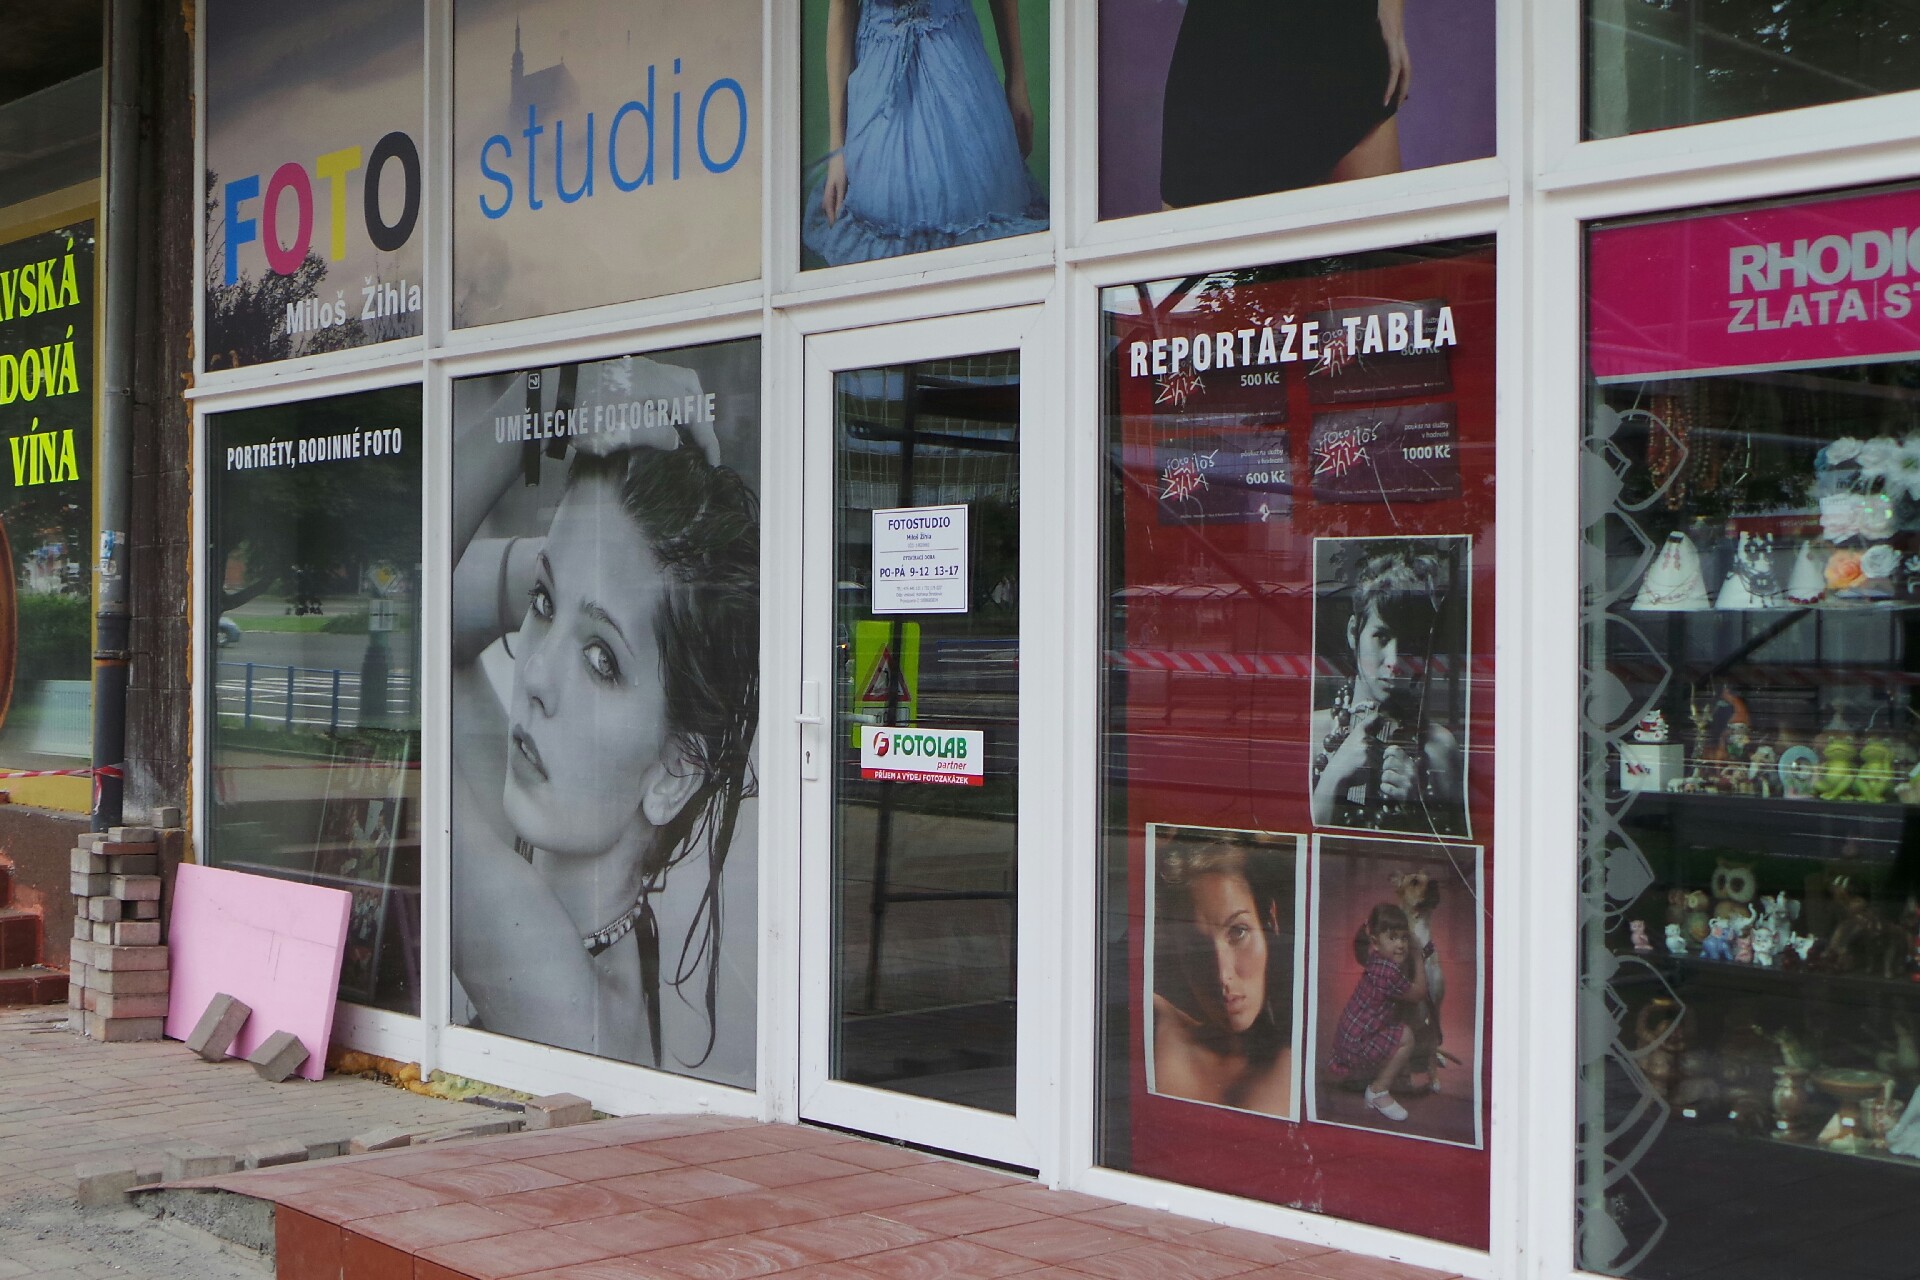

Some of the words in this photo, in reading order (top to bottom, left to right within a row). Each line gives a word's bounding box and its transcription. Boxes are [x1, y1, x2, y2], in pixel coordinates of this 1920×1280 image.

[225, 132, 421, 287] FOTO
[479, 58, 747, 219] studio
[0, 237, 80, 322] VSKÁ
[1729, 227, 1920, 294] RHODI
[286, 290, 346, 335] Miloš
[361, 276, 421, 320] Žihla
[1728, 288, 1868, 334] ZLATA
[1883, 282, 1920, 319] S
[1130, 314, 1331, 377] REPORTÁŽE,
[1342, 306, 1457, 356] TABLA
[1240, 373, 1262, 386] 500
[1265, 371, 1280, 385] Kč
[495, 401, 589, 443] UMĚLECKÉ
[594, 393, 716, 434] FOTOGRAFIE
[9, 416, 79, 487] VÍNA
[227, 437, 296, 471] PORTRÉTY,
[299, 427, 360, 463] RODINNÉ
[364, 428, 402, 456] FOTO
[1402, 447, 1432, 460] 1000
[1435, 444, 1451, 459] Kč
[1245, 472, 1268, 485] 600
[1271, 469, 1286, 483] Kč
[888, 516, 951, 531] FOTOSTUDIO
[880, 564, 906, 578] PO-PÁ
[910, 566, 930, 577] 9-12
[935, 566, 959, 576] 13-17
[894, 734, 967, 759] FOTOLAB
[936, 760, 967, 771] partner
[874, 770, 896, 780] PŘÍJEM
[896, 772, 901, 780] A
[902, 772, 922, 781] VÝDEJ
[922, 773, 968, 784] FOTOZAKÁZEK
